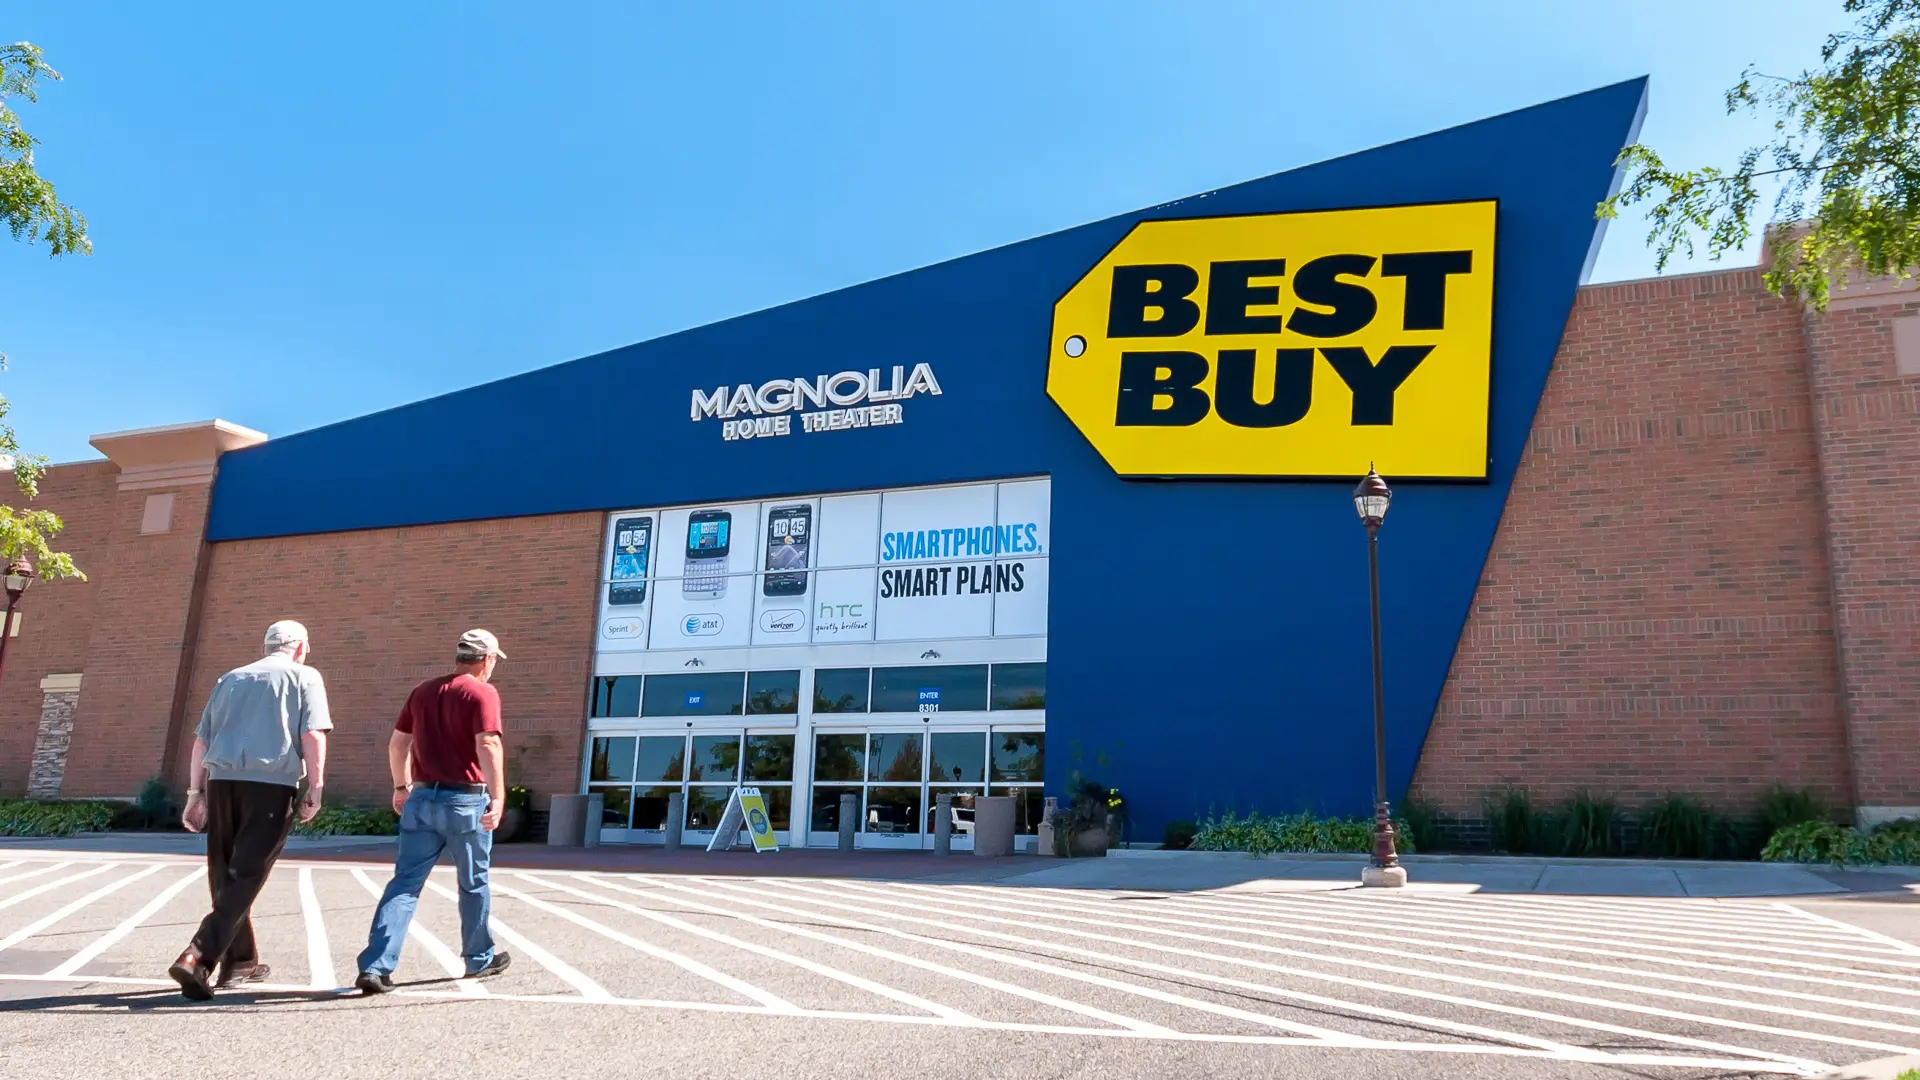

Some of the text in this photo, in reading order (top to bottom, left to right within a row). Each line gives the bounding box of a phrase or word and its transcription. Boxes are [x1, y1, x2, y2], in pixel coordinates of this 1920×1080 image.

[1106, 250, 1473, 338] BEST
[690, 362, 943, 421] MAGNOLIA
[1115, 344, 1437, 428] BUY
[722, 403, 903, 441] HOME THEATER
[775, 520, 805, 535] 10 45
[621, 530, 646, 544] 10 54
[882, 522, 1043, 561] SMARTPHONES,
[880, 562, 1025, 599] SMART PLANS
[608, 624, 628, 635] Sprint
[702, 620, 718, 629] at&t
[770, 622, 794, 630] verizon
[815, 620, 868, 635] quietly brilliant
[919, 703, 939, 712] 8301
